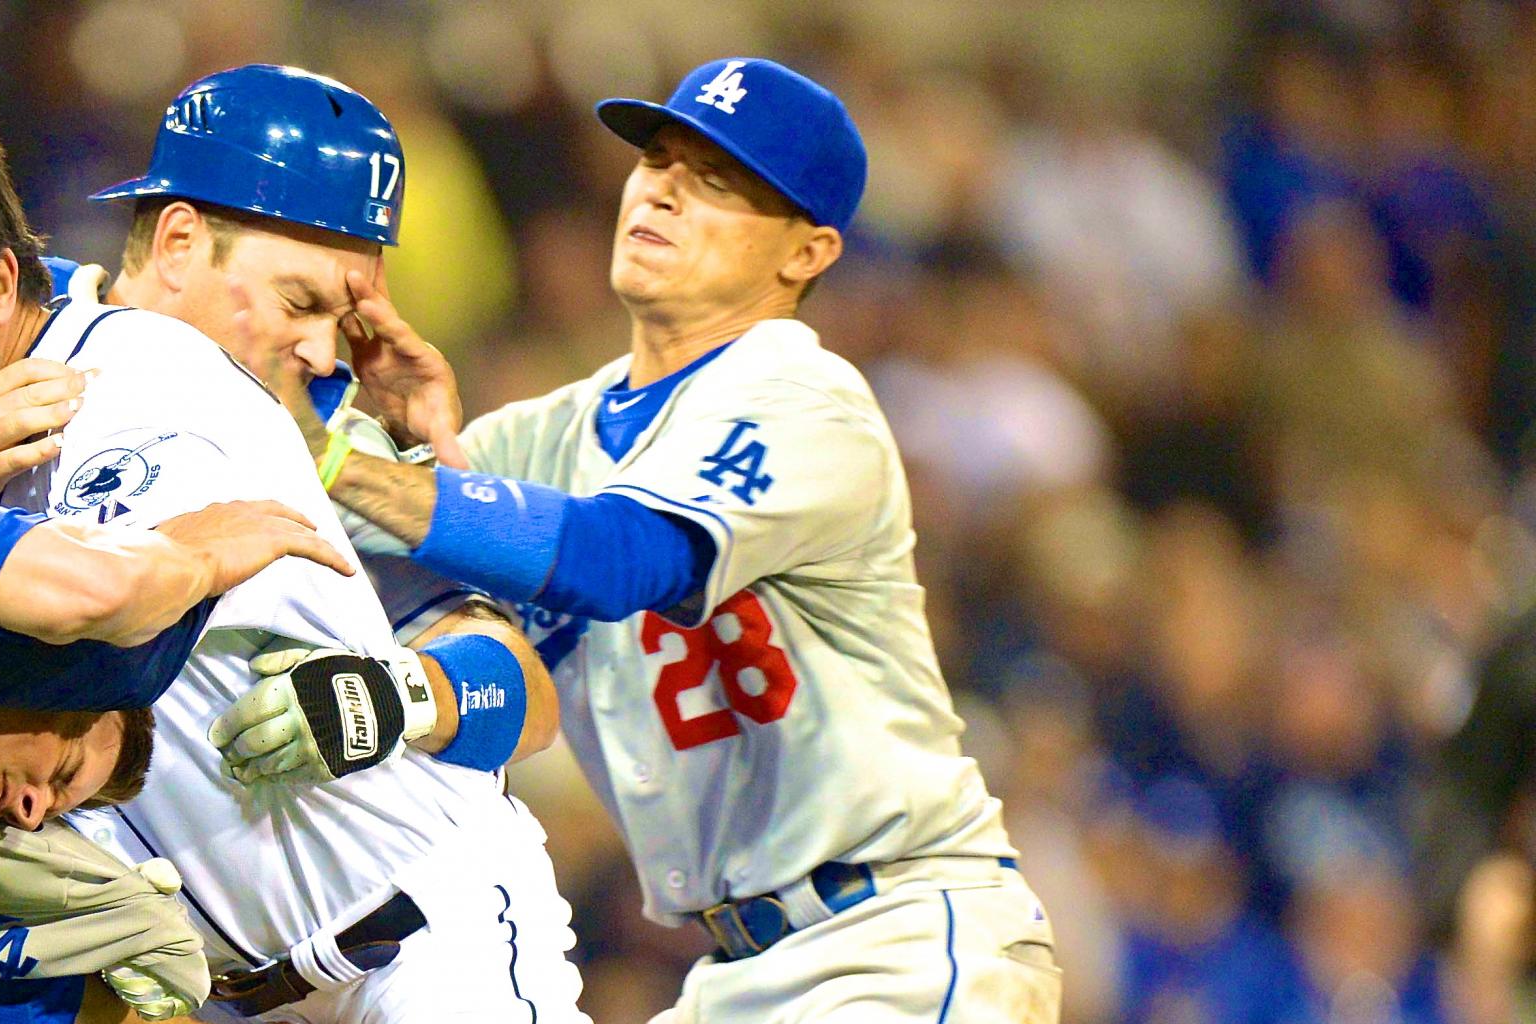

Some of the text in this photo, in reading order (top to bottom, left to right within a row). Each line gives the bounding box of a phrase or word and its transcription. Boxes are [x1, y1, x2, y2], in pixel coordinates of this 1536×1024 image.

[695, 61, 748, 114] LA
[369, 151, 400, 200] 17
[698, 420, 773, 504] LA
[640, 588, 798, 752] 28
